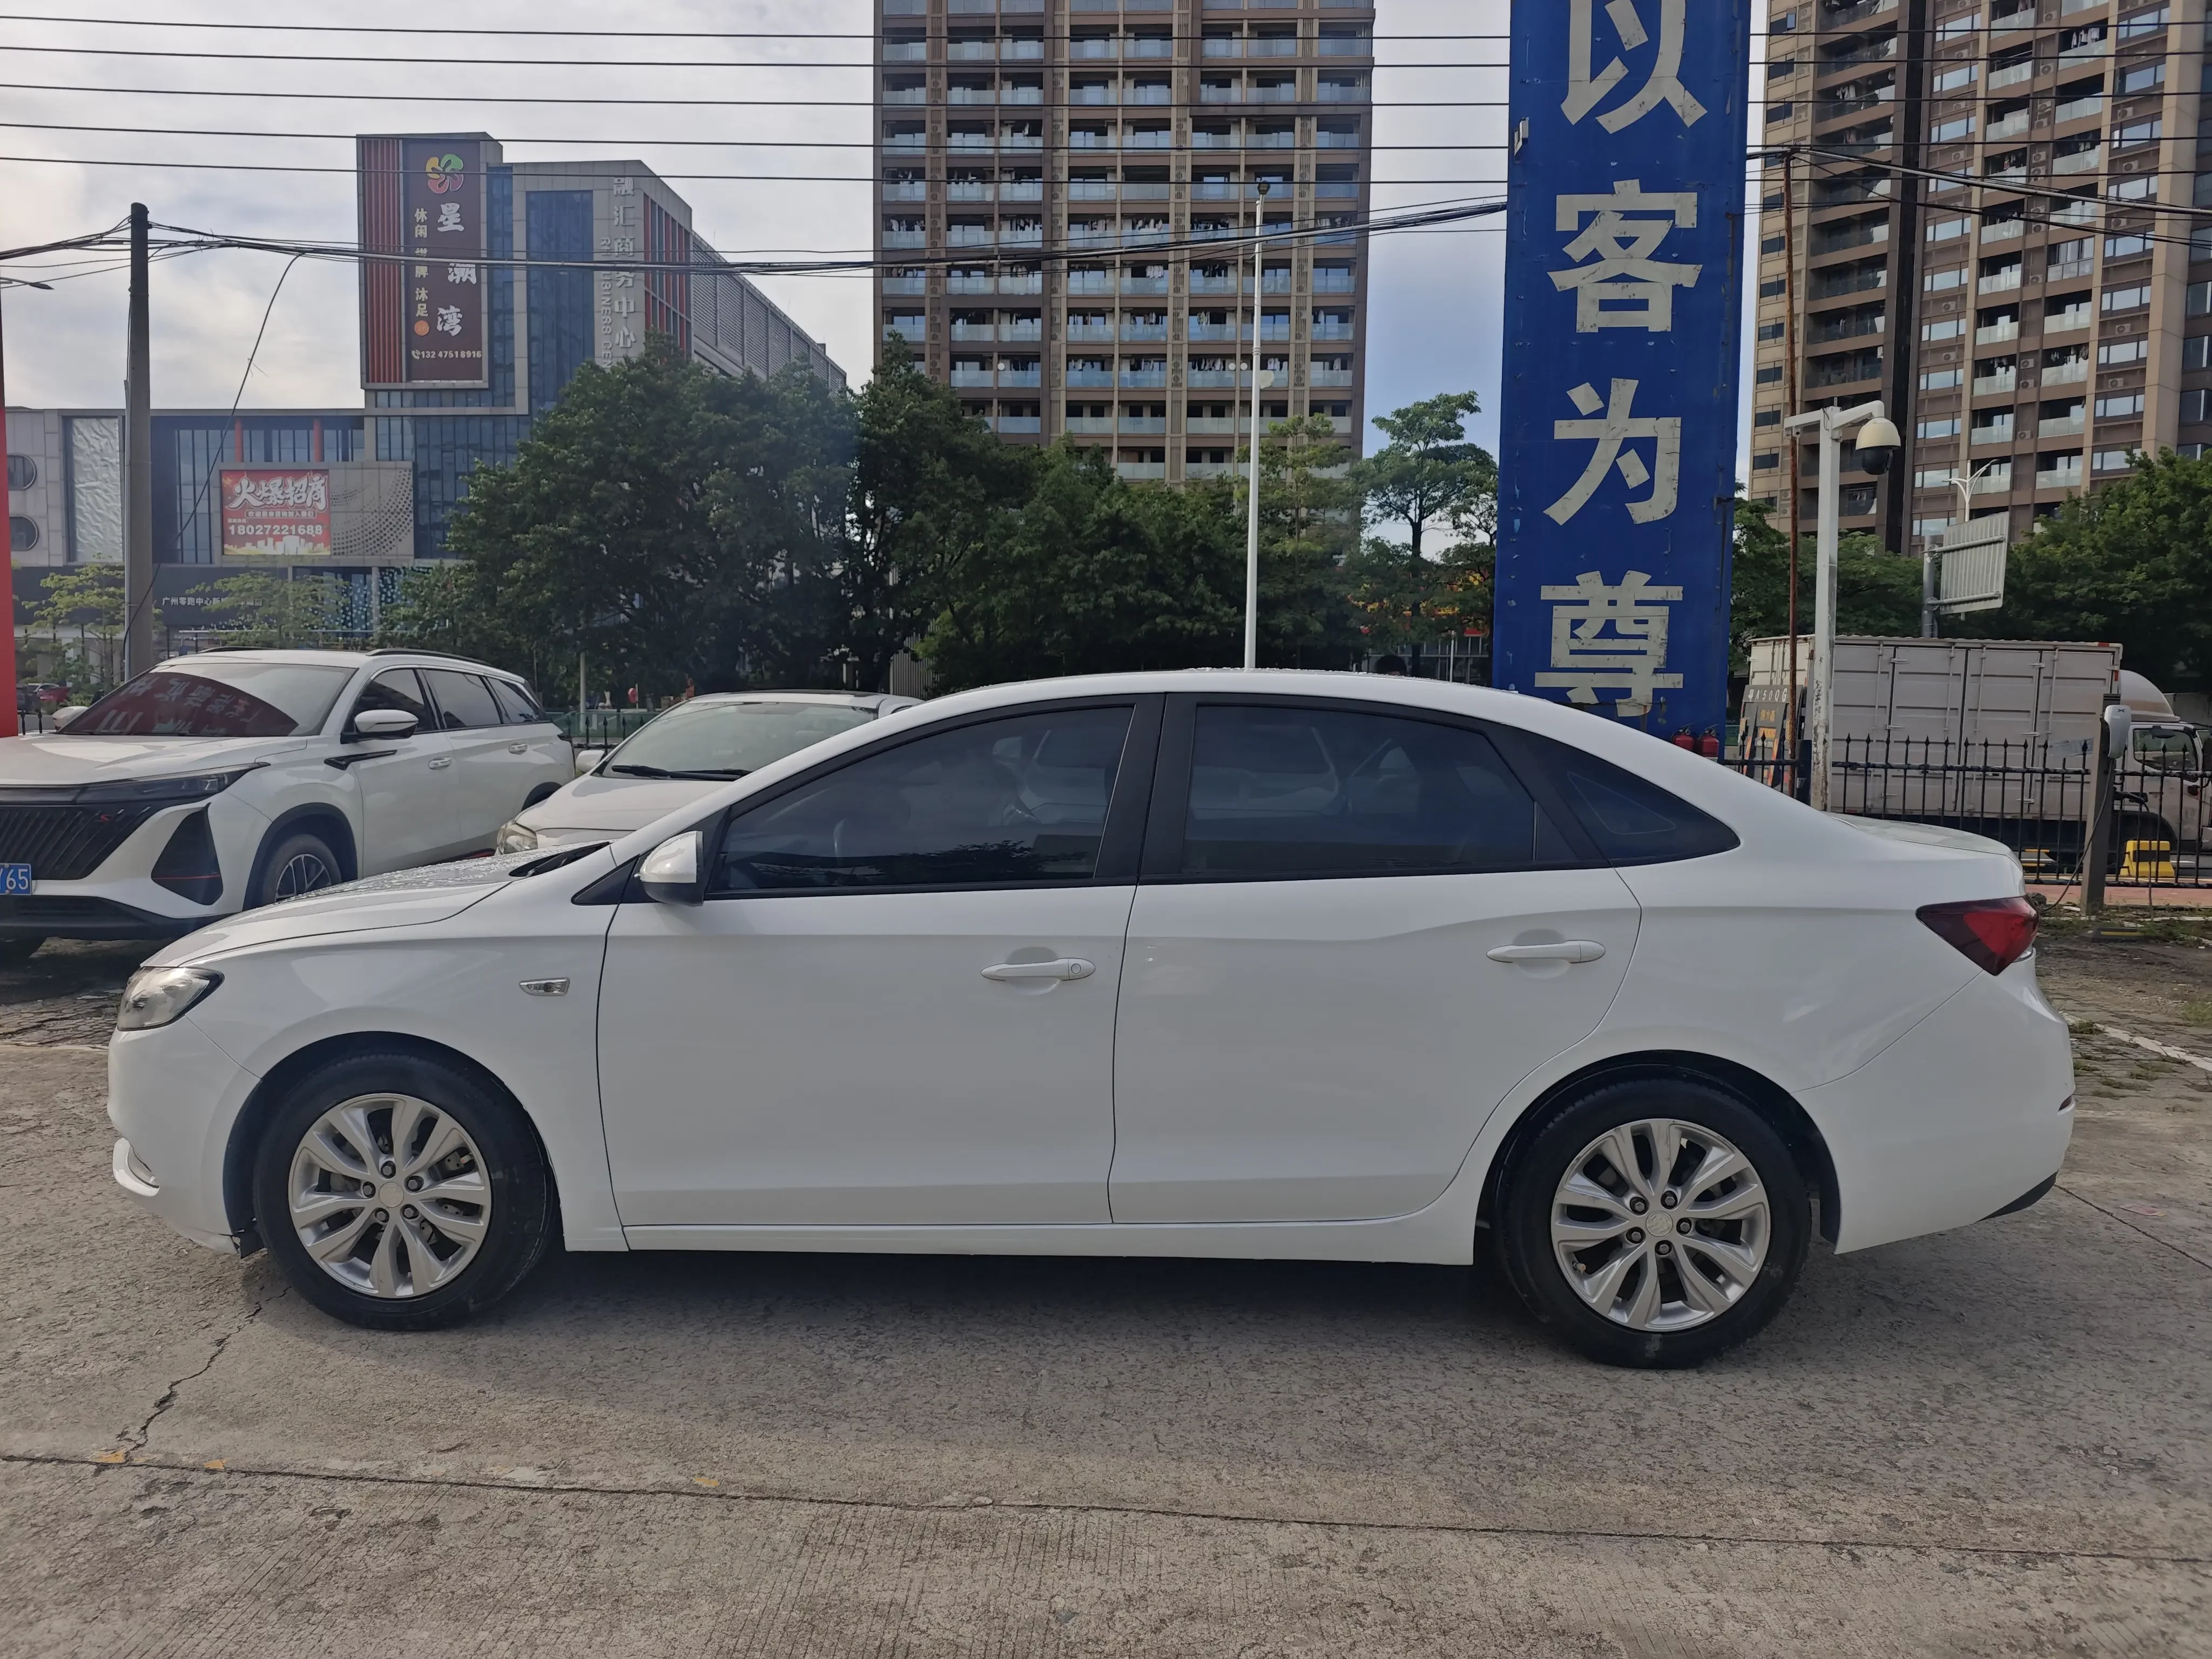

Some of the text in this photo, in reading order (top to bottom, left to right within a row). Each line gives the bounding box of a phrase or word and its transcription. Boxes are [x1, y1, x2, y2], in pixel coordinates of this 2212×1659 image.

[414, 207, 428, 238] 休闲
[613, 177, 636, 348] 融汇商务中心
[601, 264, 612, 335] USINESS
[421, 350, 436, 359] 132
[1534, 0, 1708, 717] 以客为尊
[226, 473, 328, 511] 火爆招商
[229, 524, 323, 535] 18027221688
